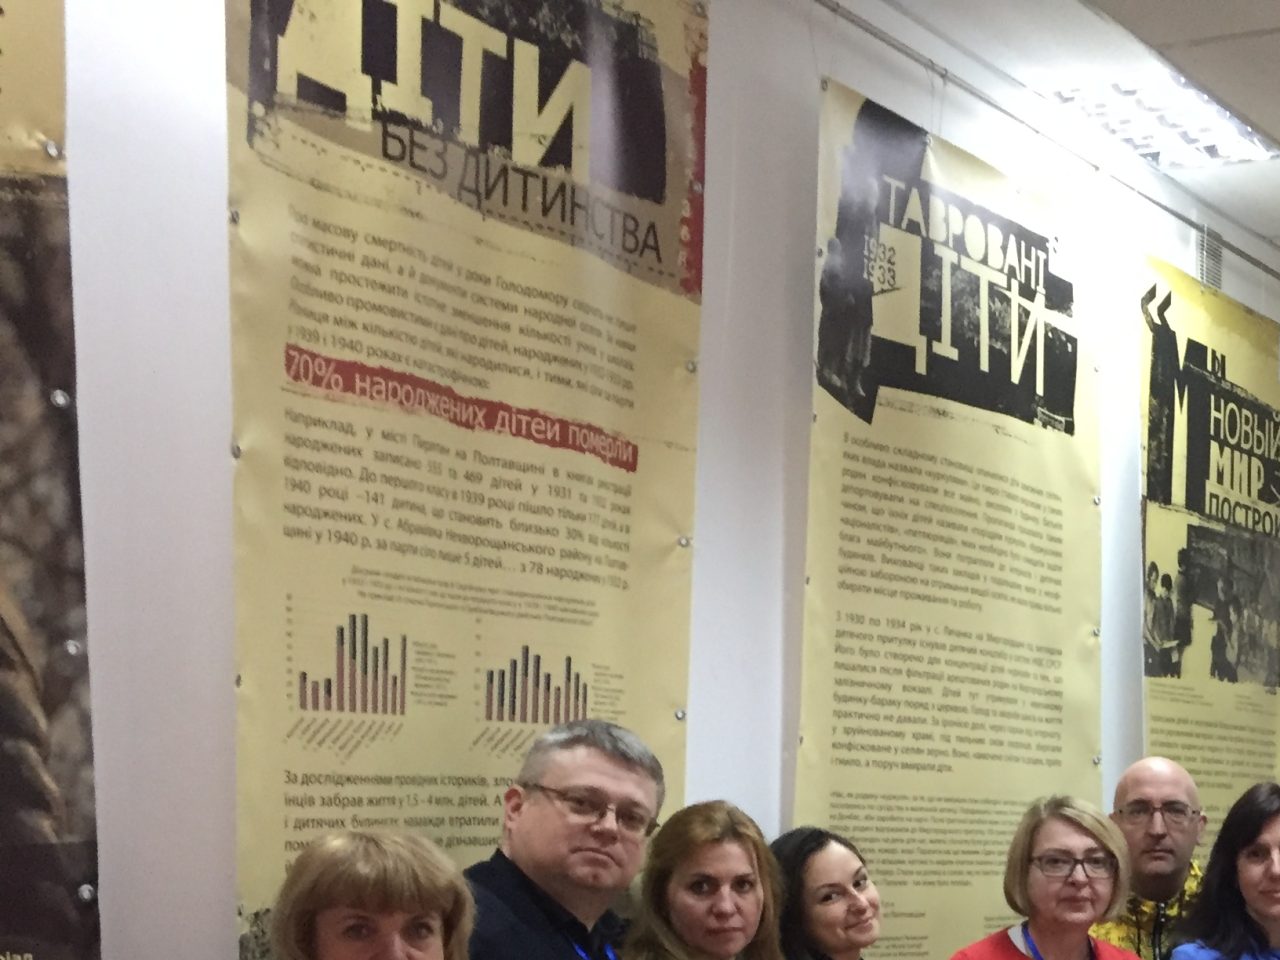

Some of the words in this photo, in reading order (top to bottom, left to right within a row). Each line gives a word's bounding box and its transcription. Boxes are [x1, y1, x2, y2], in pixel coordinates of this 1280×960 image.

[382, 122, 448, 180] БЕЗ
[457, 149, 662, 264] ДИТИНСТВА
[883, 174, 1047, 296] ТАВРОВАНІ
[496, 275, 568, 308] Голодомору
[871, 222, 1046, 396] ДІТИ
[330, 334, 364, 354] 1940
[289, 350, 344, 392] 70%
[354, 372, 487, 430] народжених
[568, 425, 633, 463] померли
[473, 450, 545, 475] Полтавщині
[1209, 440, 1265, 499] МИР
[284, 477, 311, 494] 1940
[510, 518, 559, 538] близько
[359, 467, 377, 483] До
[461, 489, 484, 505] 1939
[519, 500, 554, 518] пішло
[490, 476, 522, 491] дітей
[549, 485, 572, 501] 1931
[314, 531, 322, 544] у
[327, 529, 359, 546] 1940
[529, 561, 544, 576] 78
[284, 769, 298, 786] За
[292, 817, 346, 832] дитячих
[319, 794, 363, 811] забрав
